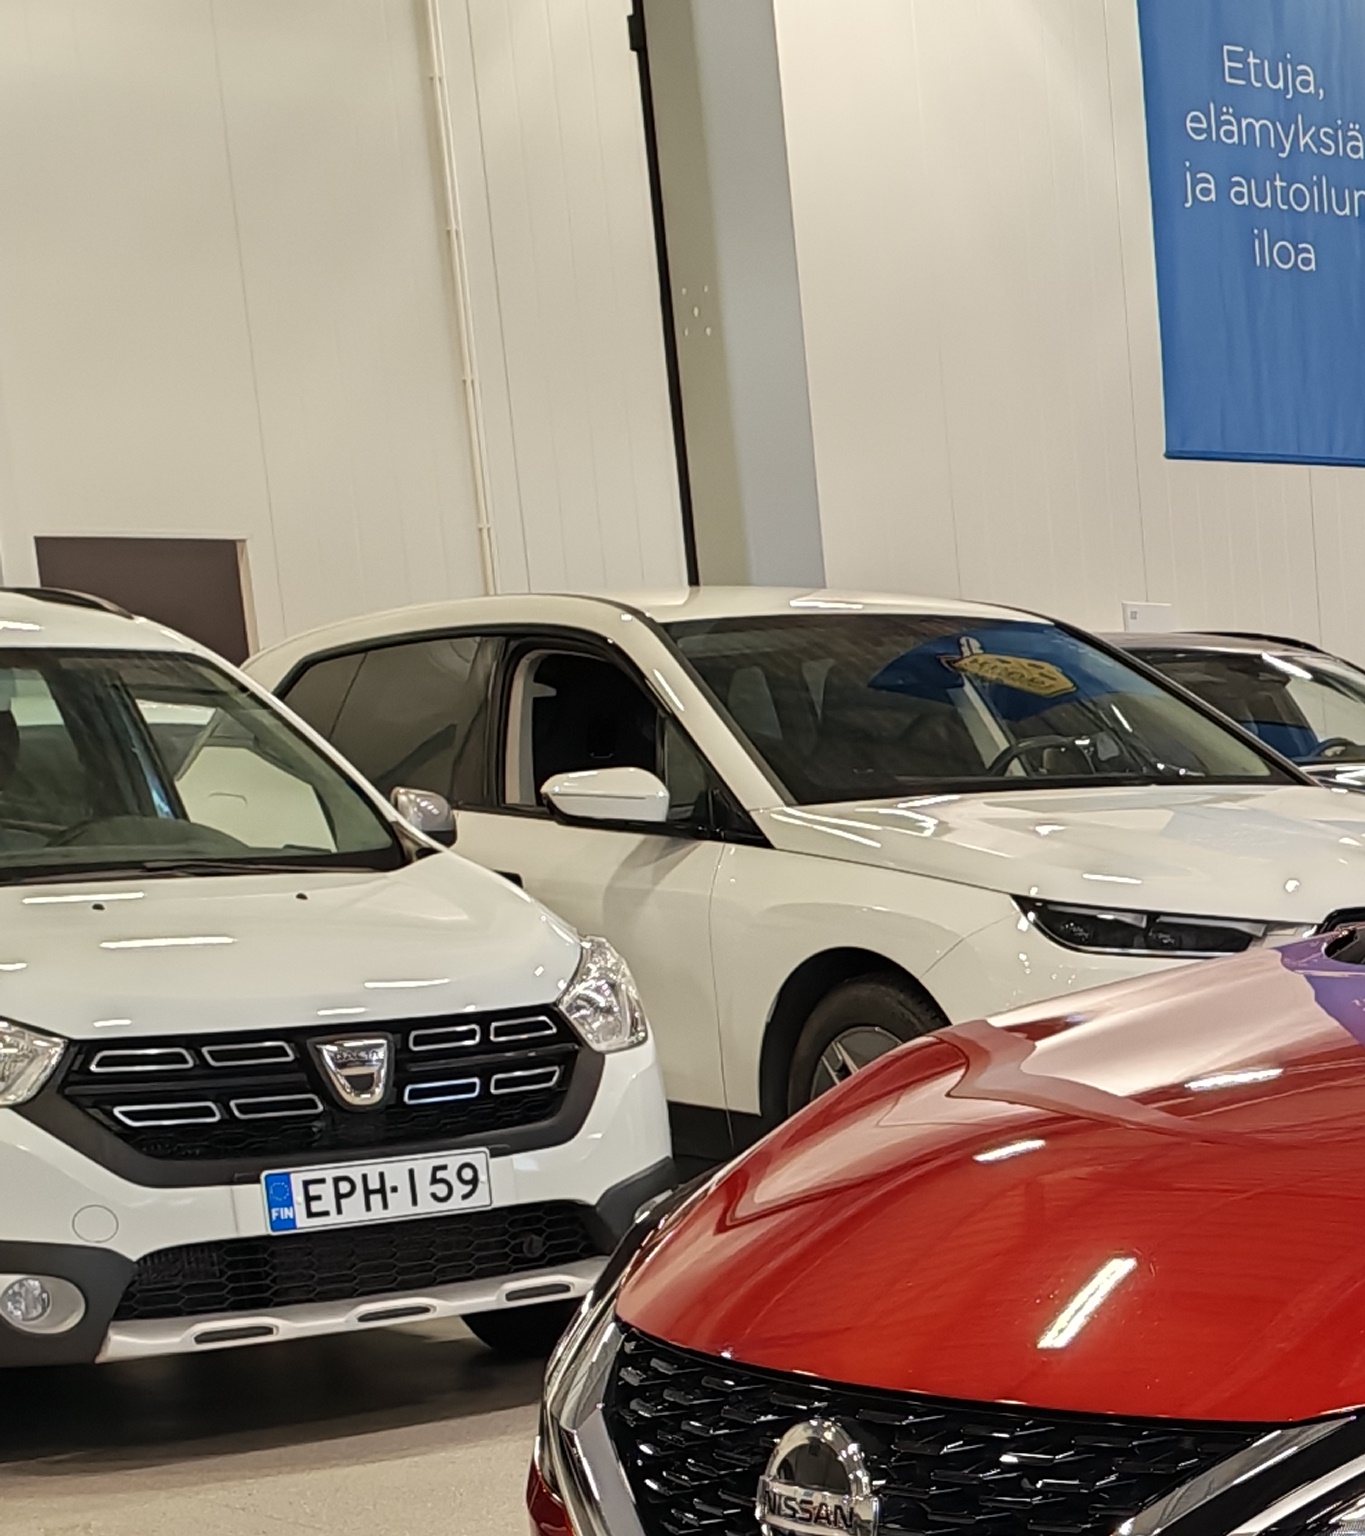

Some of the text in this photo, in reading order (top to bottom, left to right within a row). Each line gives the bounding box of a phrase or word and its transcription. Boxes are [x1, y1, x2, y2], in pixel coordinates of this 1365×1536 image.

[1223, 45, 1324, 100] Etuja,
[1185, 101, 1365, 160] elämyksiä
[1184, 161, 1216, 208] ja
[1253, 228, 1316, 272] iloa
[271, 1162, 480, 1222] FIN EPH-159
[765, 1490, 855, 1529] NISSAN
